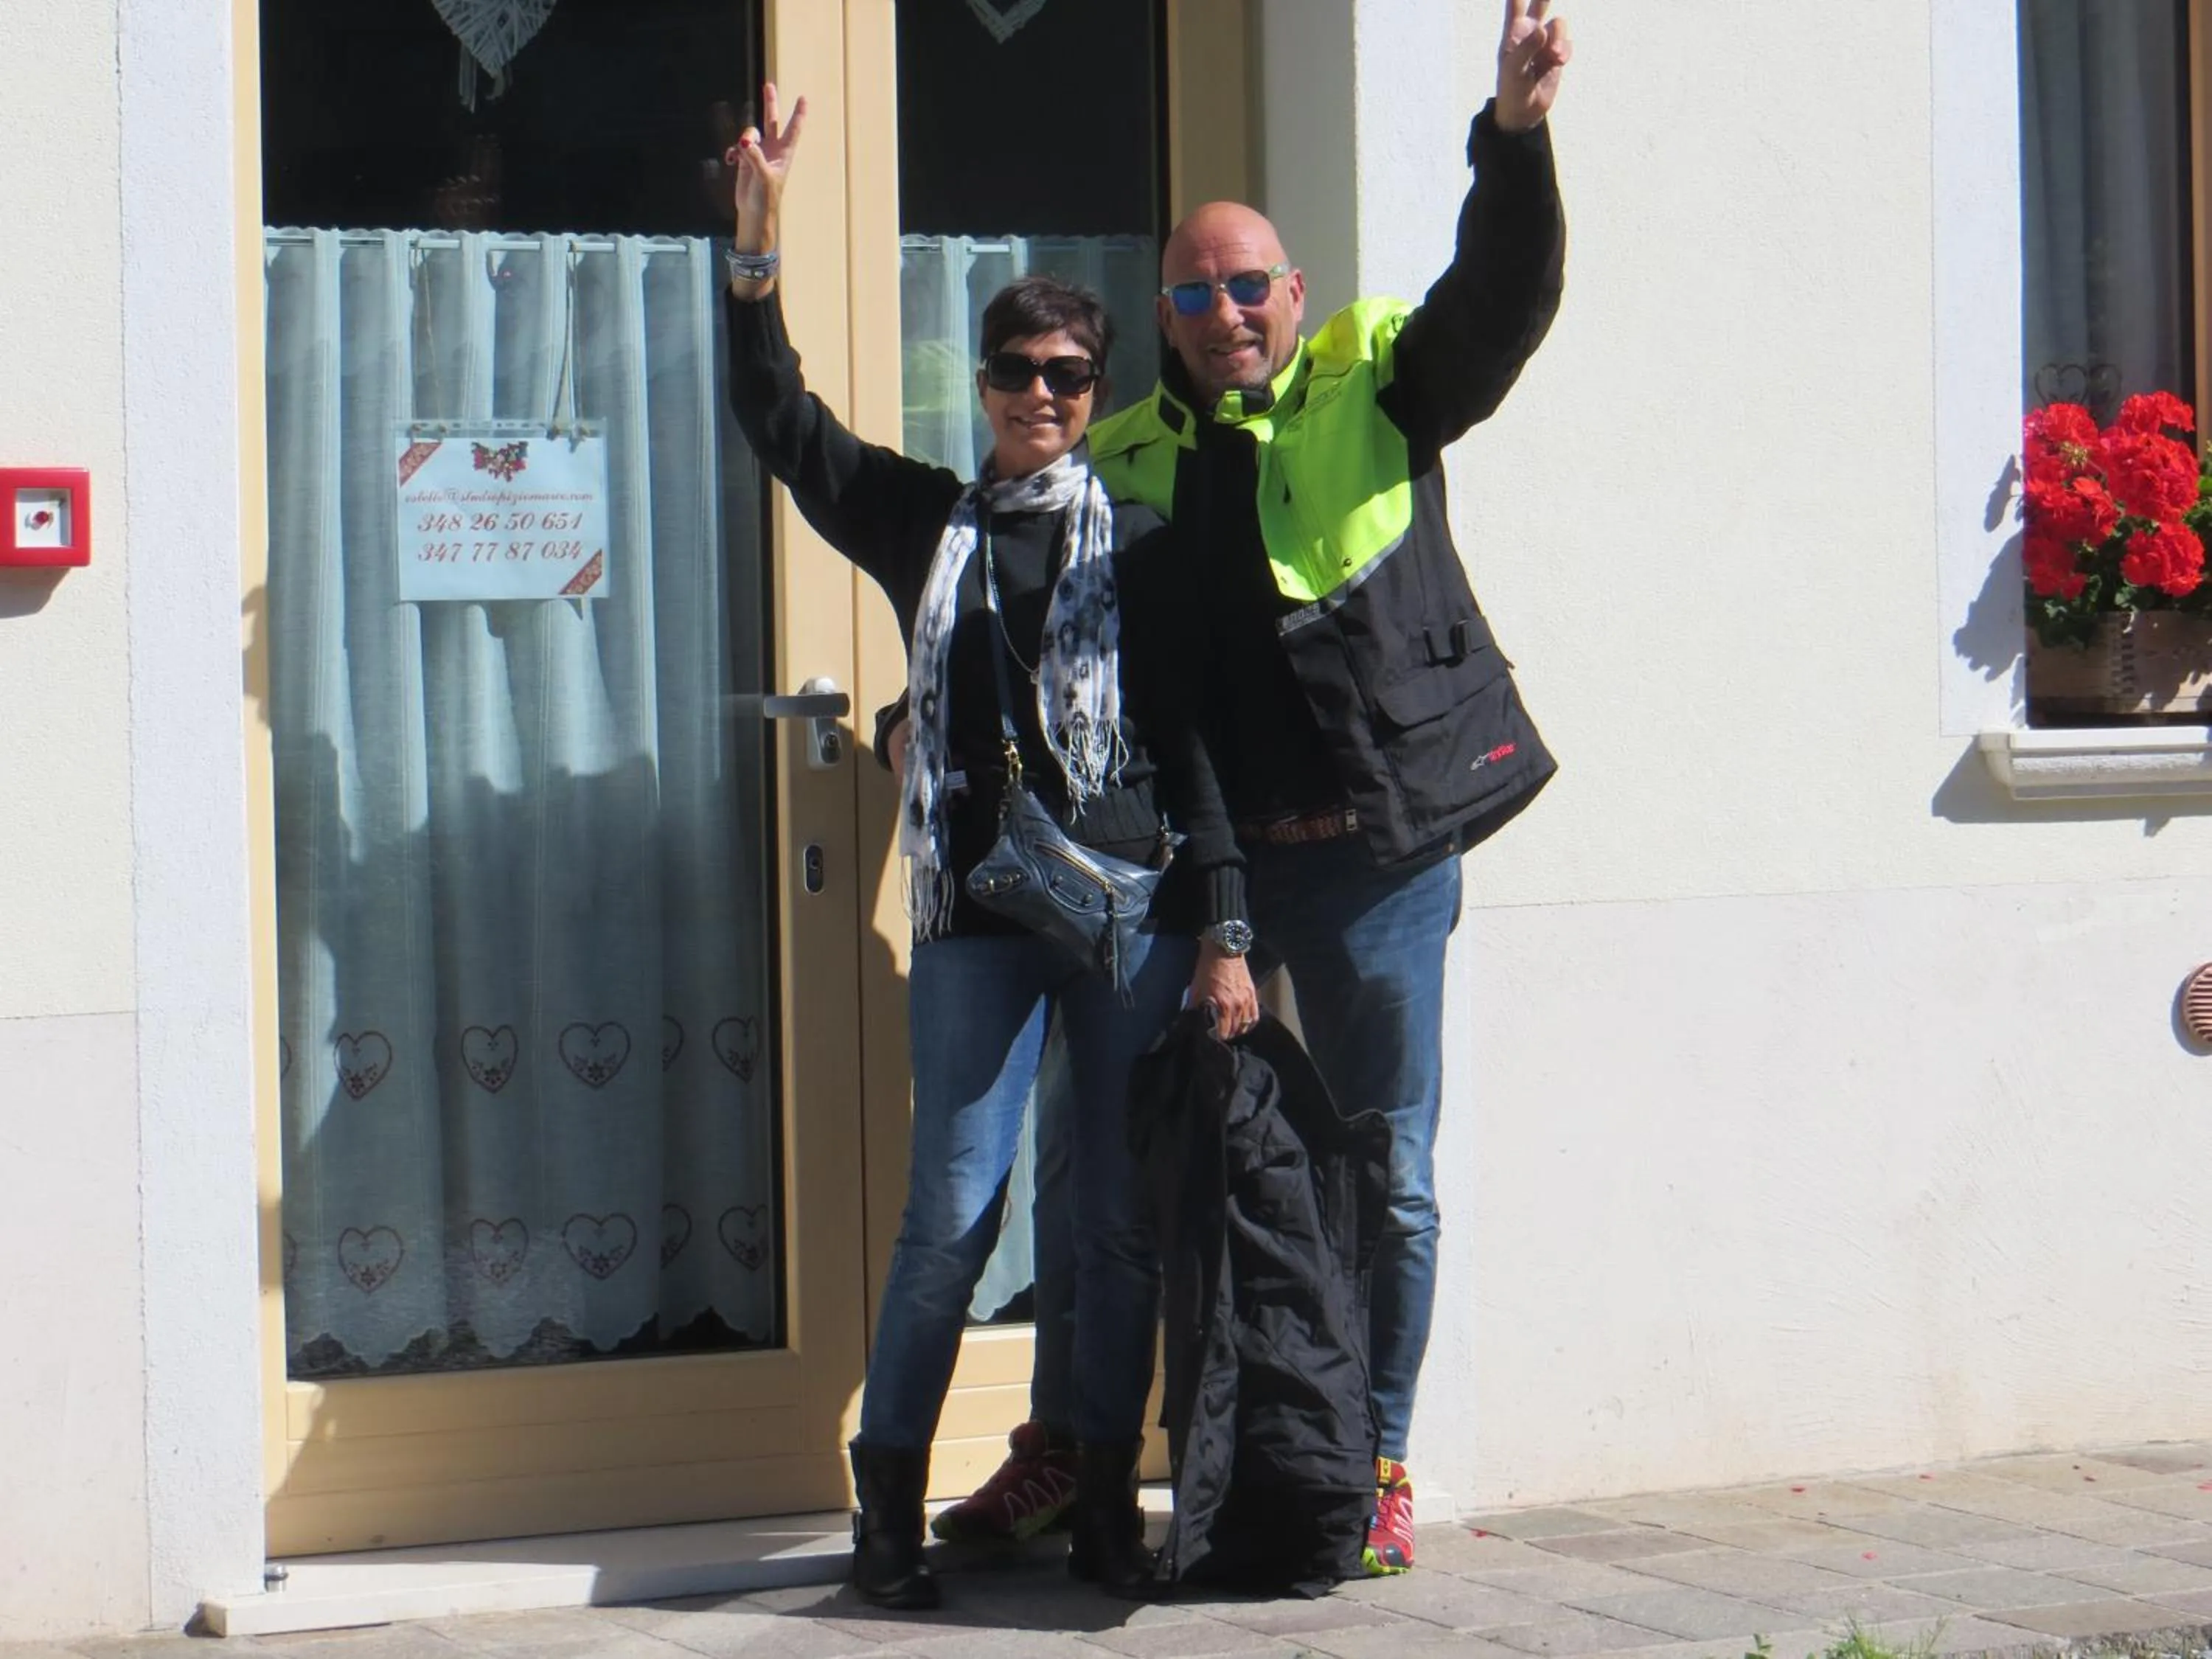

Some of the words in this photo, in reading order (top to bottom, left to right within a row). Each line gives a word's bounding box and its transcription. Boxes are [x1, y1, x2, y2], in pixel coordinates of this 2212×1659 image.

[417, 512, 462, 533] 348
[470, 512, 499, 531] 26
[504, 512, 535, 531] 50
[541, 512, 583, 530] 651
[418, 542, 463, 563] 347
[472, 542, 498, 562] 77
[505, 542, 535, 561] 87
[541, 540, 583, 560] 034
